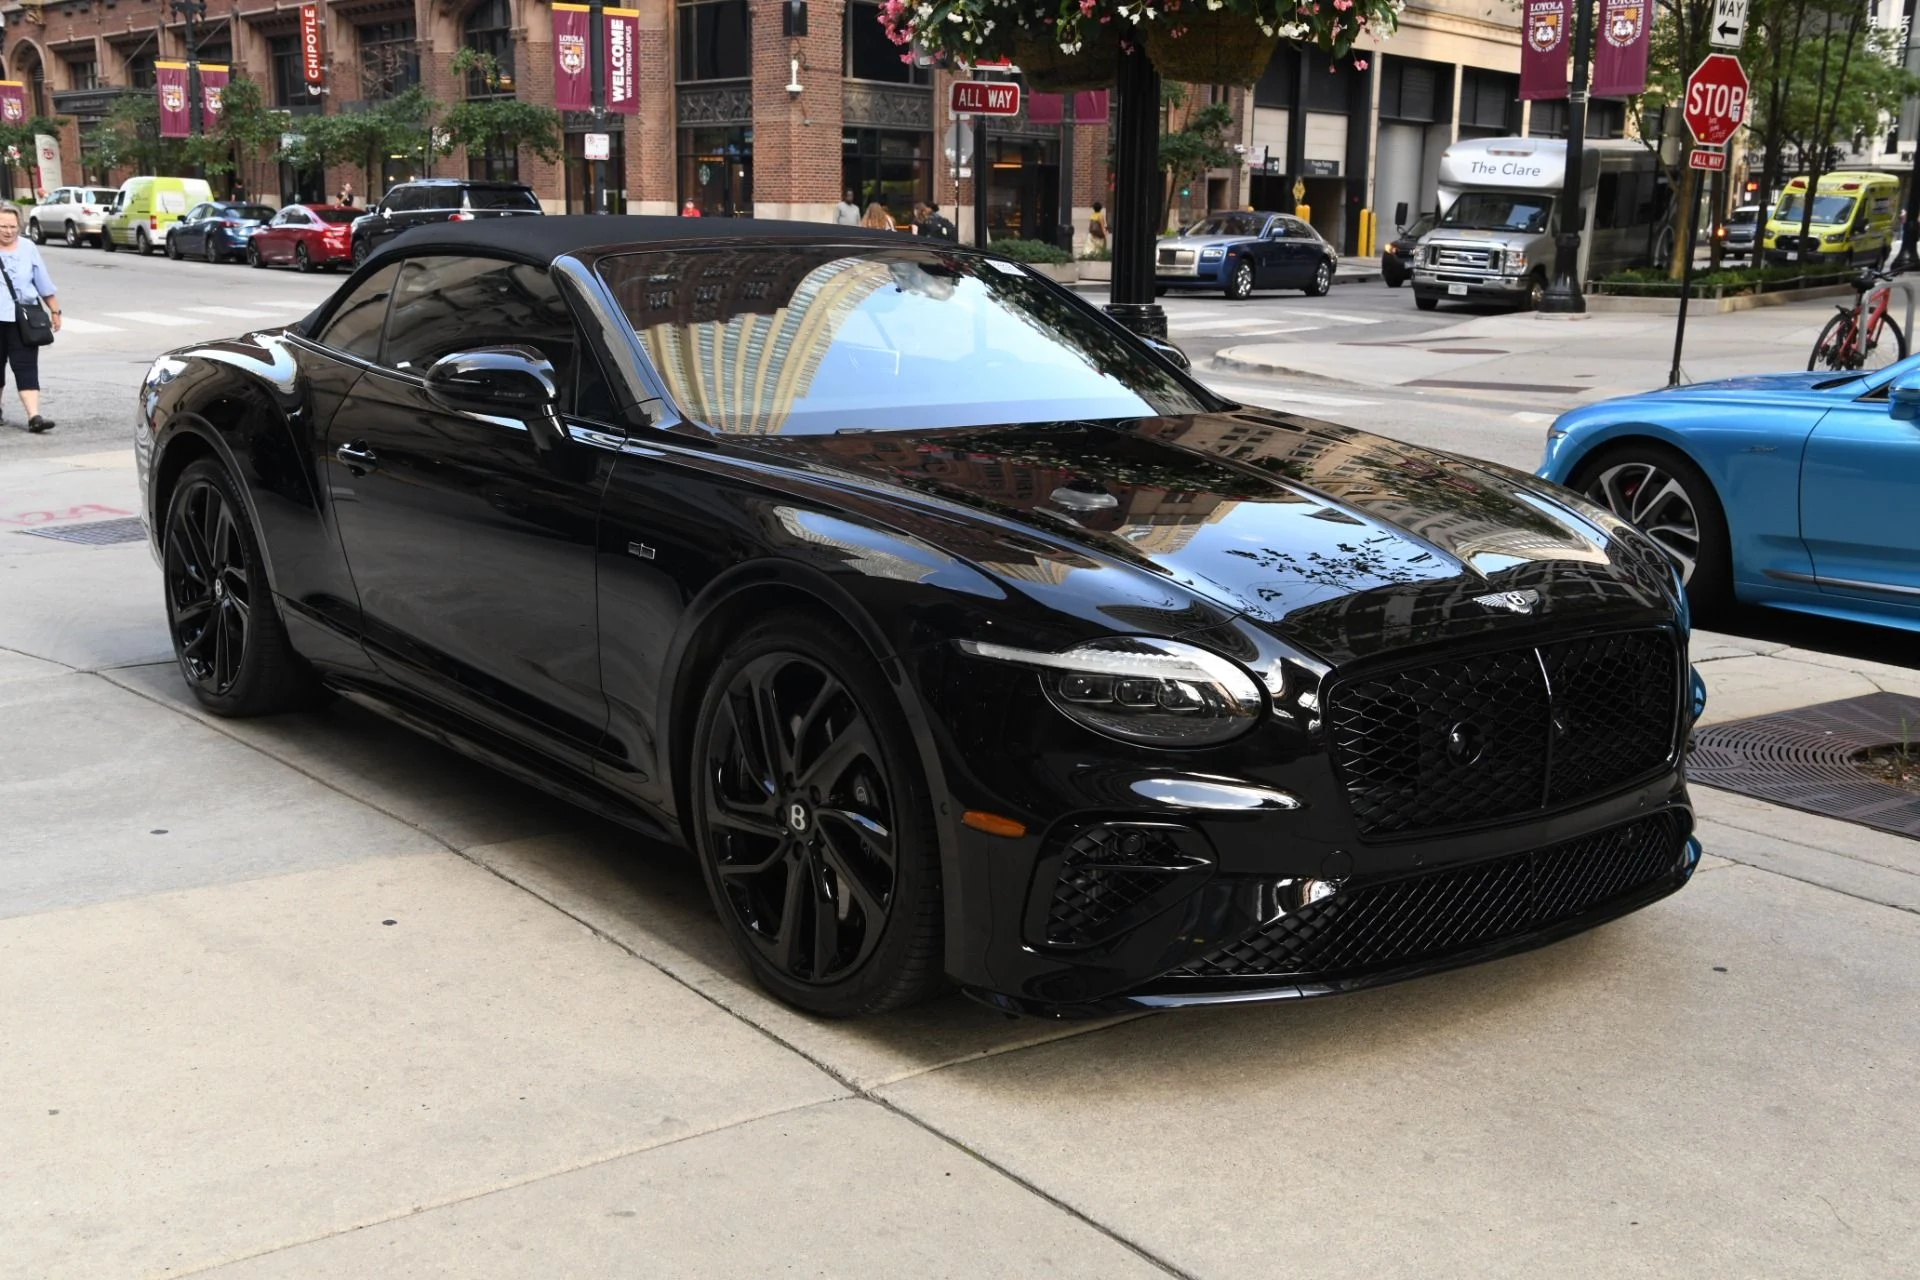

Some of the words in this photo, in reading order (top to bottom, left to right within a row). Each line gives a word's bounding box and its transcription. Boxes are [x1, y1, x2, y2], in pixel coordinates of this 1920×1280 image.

[1530, 2, 1563, 12] LOYOLA
[1719, 0, 1744, 18] WAY
[305, 9, 318, 79] CHIPOTLE
[559, 34, 584, 42] LOYOLA
[611, 19, 624, 102] WELCOME
[958, 88, 982, 107] ALL
[988, 90, 1013, 108] WAY
[1689, 82, 1744, 119] STOP
[1471, 161, 1497, 175] The
[1502, 162, 1541, 177] Clare
[1693, 154, 1706, 166] ALL
[1709, 155, 1722, 168] WAY
[791, 804, 806, 830] B
